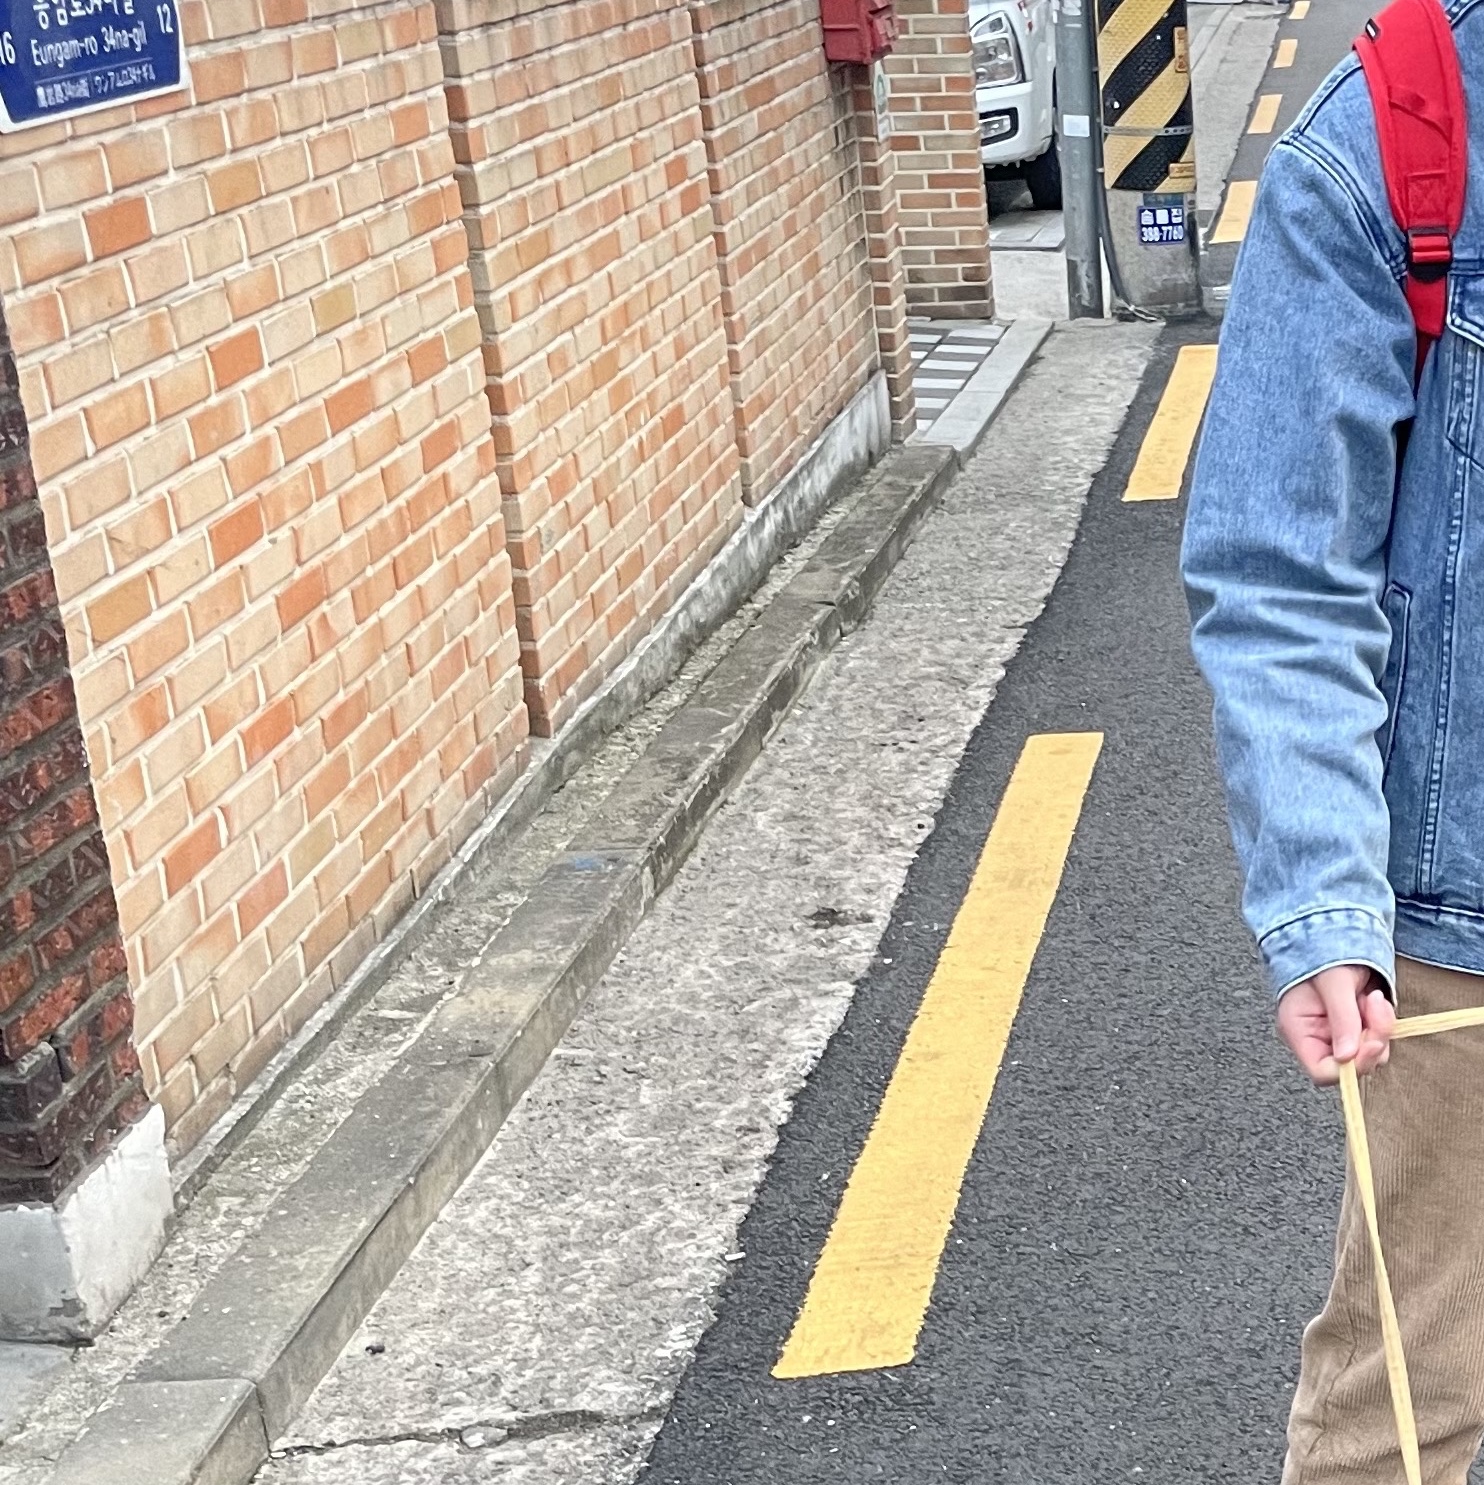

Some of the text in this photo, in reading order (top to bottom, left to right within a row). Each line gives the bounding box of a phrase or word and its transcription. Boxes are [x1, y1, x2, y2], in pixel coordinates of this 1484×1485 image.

[156, 3, 174, 33] 12
[30, 20, 147, 68] Eungam-ro 34na-gil
